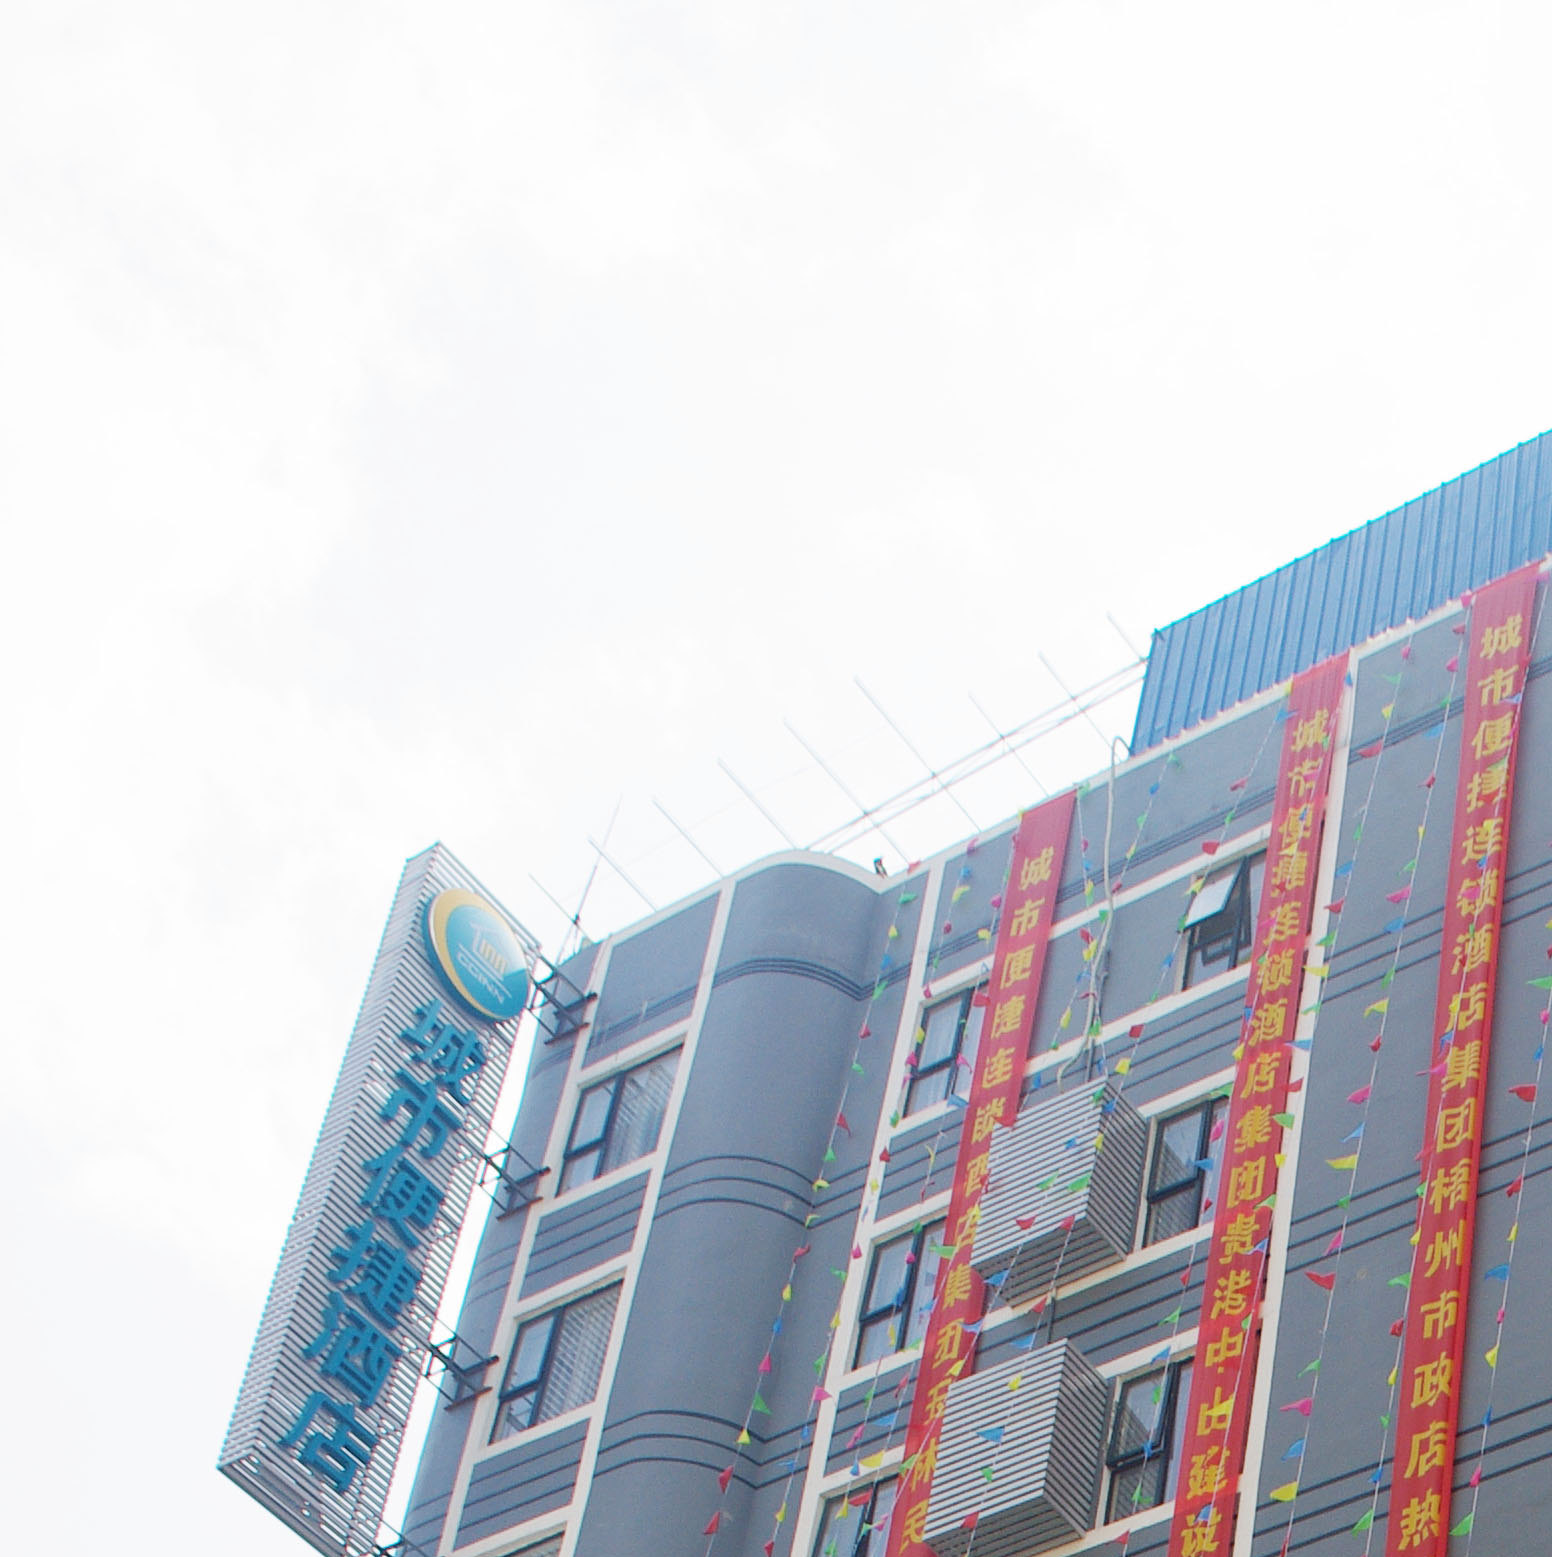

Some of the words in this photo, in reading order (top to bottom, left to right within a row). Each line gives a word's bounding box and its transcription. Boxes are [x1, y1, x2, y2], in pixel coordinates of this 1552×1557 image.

[281, 997, 488, 1495] 城市便捷酒店
